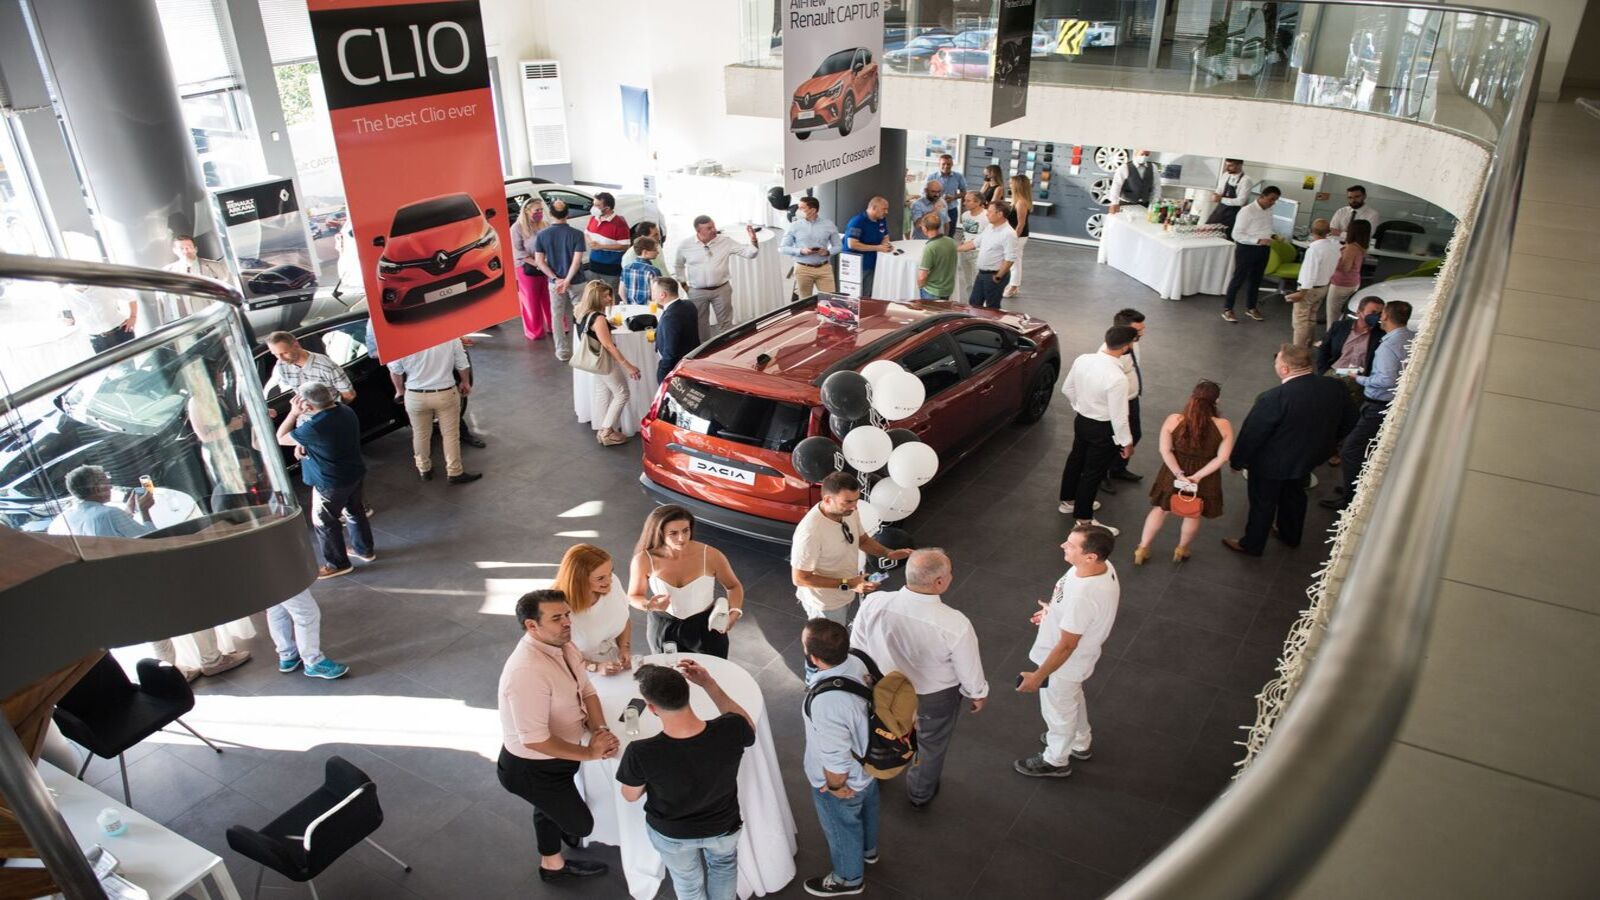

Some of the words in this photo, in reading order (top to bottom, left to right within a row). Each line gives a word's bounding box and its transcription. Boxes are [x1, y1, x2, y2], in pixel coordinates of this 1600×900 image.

[790, 7, 835, 29] Renault
[837, 2, 880, 22] CAPTUR
[337, 21, 470, 86] CLIO
[352, 118, 383, 134] The
[385, 113, 417, 129] best
[420, 107, 446, 123] Clio
[448, 104, 477, 119] ever
[805, 157, 841, 177] Απόλυτο
[842, 145, 877, 165] Crossover
[697, 462, 746, 480] DACIA
